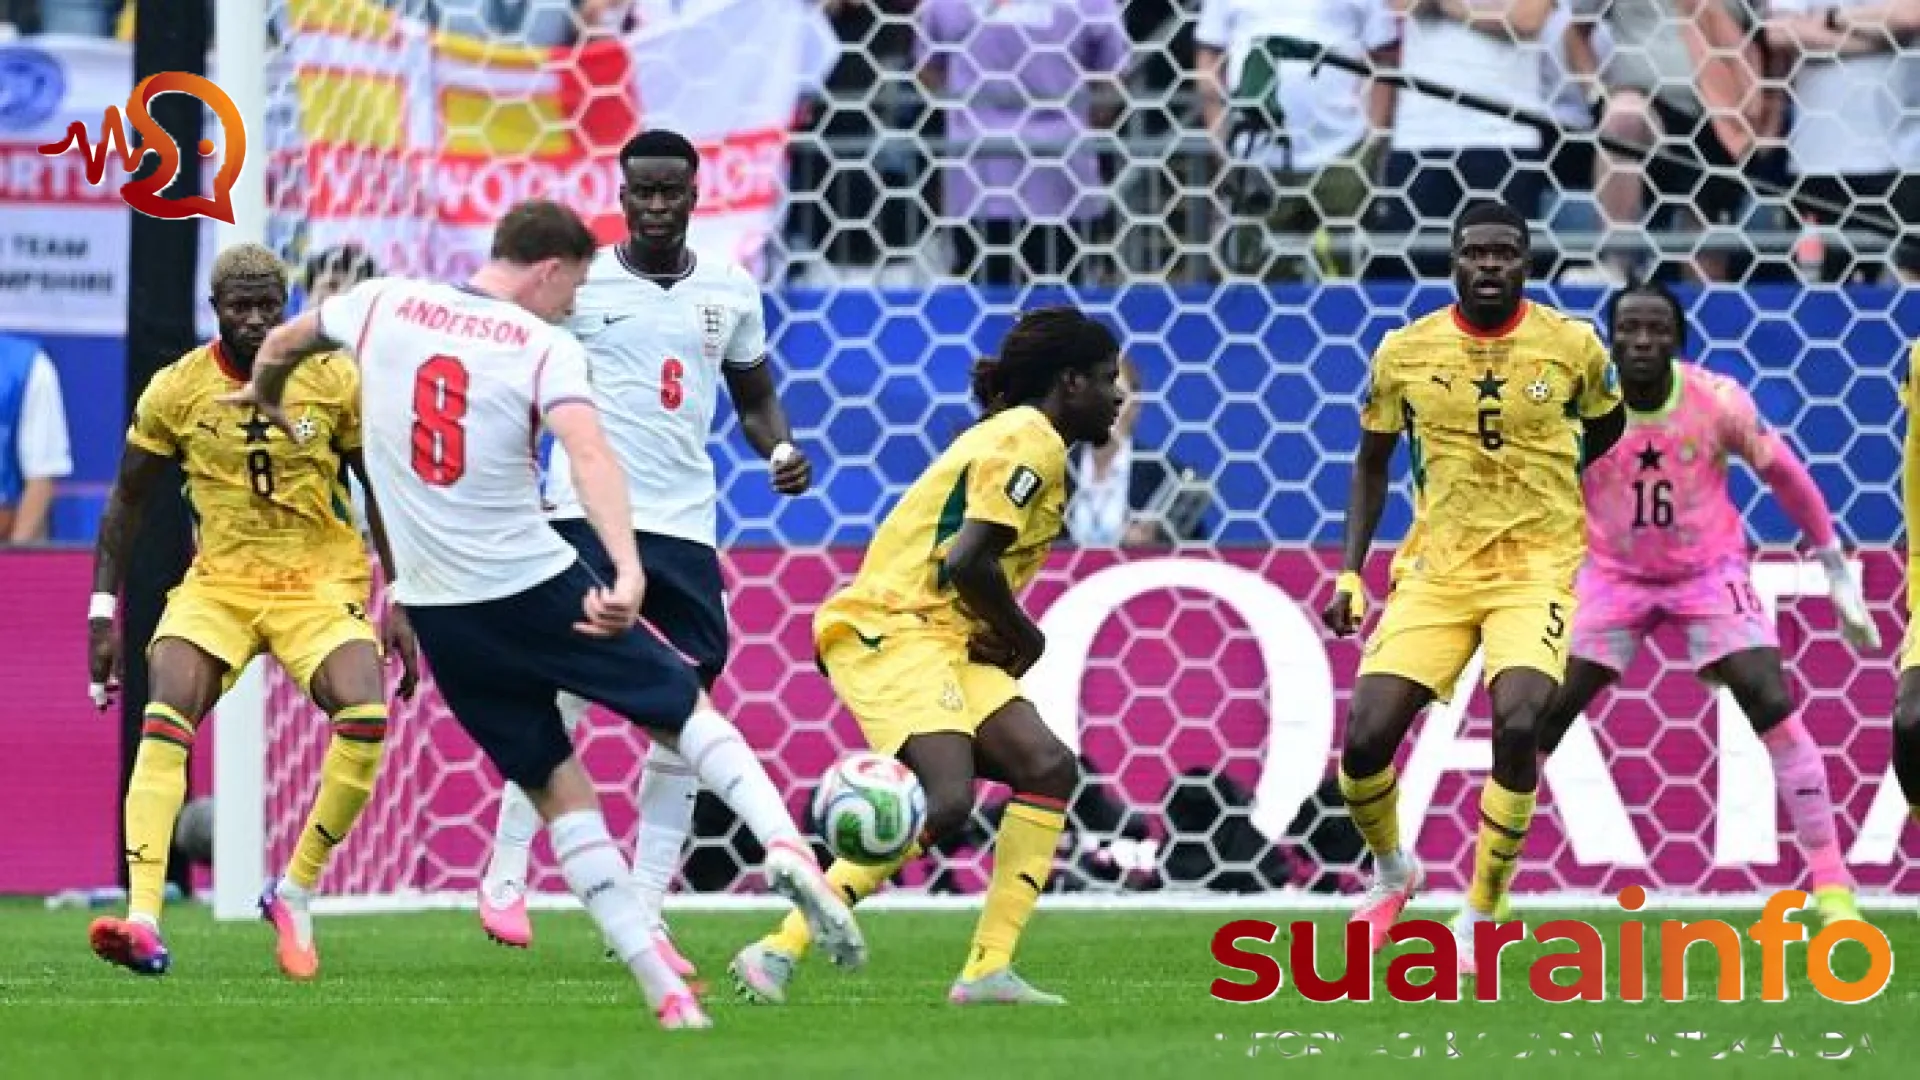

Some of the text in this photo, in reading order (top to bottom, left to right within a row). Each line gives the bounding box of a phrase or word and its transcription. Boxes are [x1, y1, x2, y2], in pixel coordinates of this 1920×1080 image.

[396, 297, 531, 347] ANDERSON
[660, 358, 684, 410] 6
[411, 353, 469, 487] 8
[249, 449, 274, 497] 8
[1631, 480, 1674, 528] 16
[1546, 601, 1565, 638] 5
